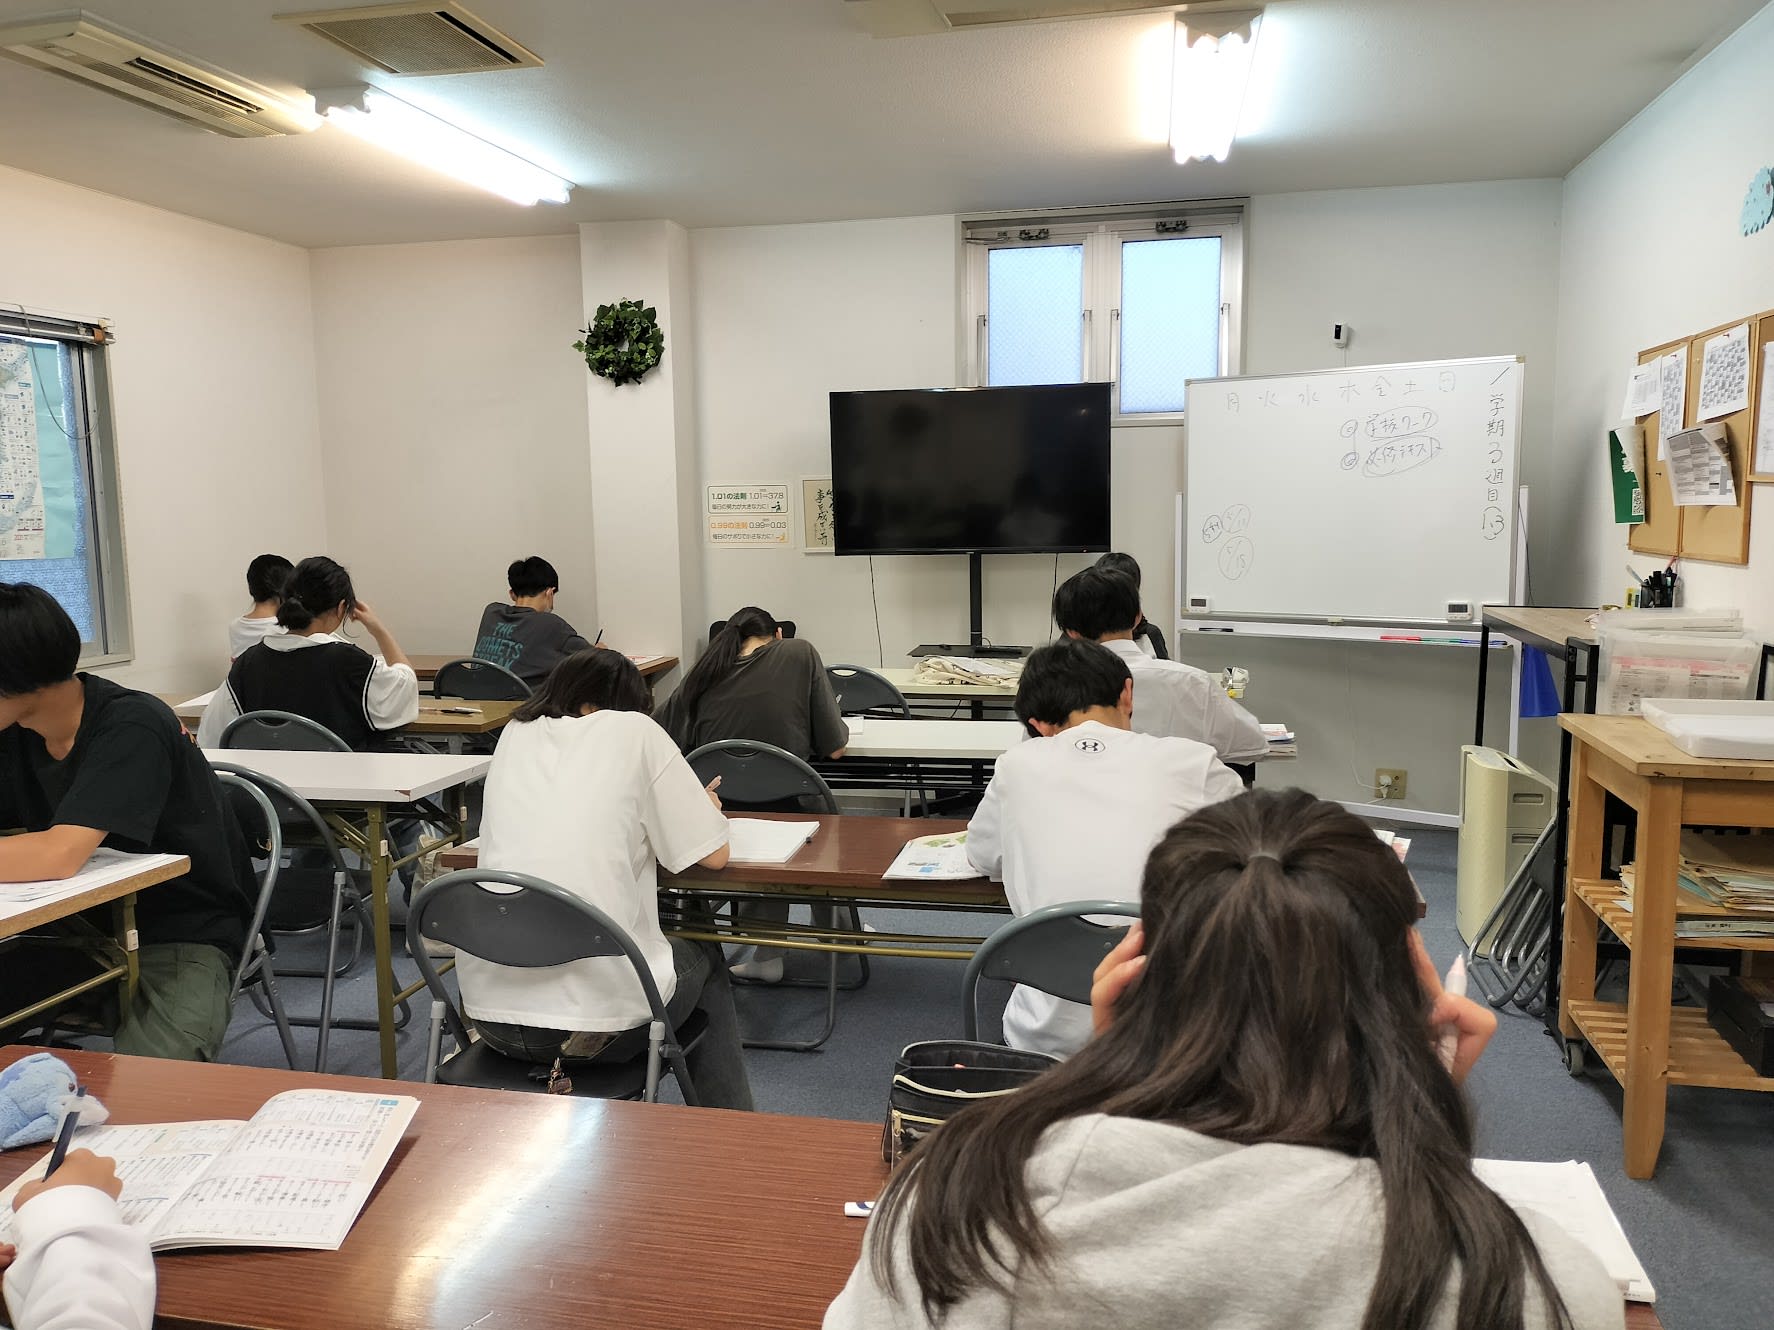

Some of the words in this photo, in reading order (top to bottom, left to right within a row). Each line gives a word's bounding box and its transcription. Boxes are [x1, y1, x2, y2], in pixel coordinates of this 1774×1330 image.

[1338, 379, 1361, 403] 木
[1402, 379, 1425, 396] 土
[493, 622, 518, 639] THE
[476, 636, 523, 659] COMETS
